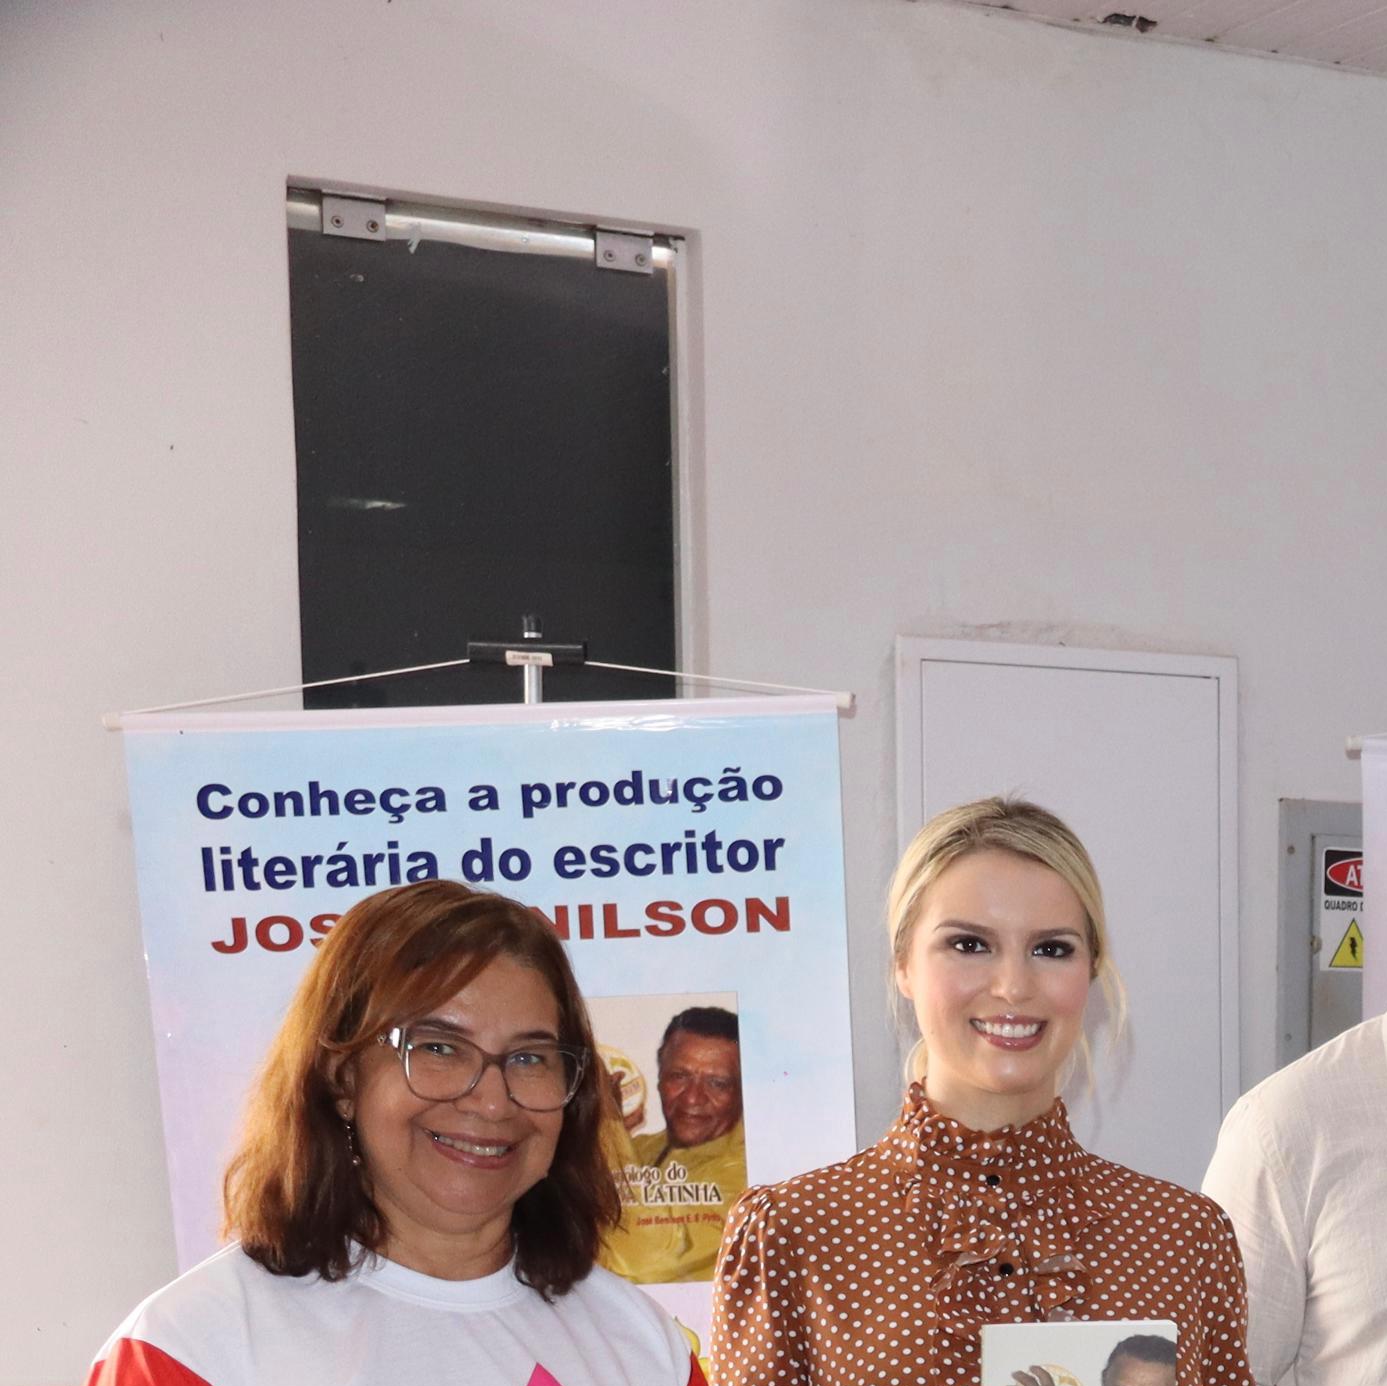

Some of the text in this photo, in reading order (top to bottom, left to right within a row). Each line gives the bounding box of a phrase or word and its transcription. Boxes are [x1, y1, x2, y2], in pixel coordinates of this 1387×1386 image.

[196, 767, 783, 824] Conheça a produção
[201, 829, 786, 892] literária do escritor
[527, 896, 790, 940] NILSON
[1324, 900, 1357, 912] QUADRO
[667, 1162, 686, 1180] do
[643, 1183, 722, 1203] LATINHA
